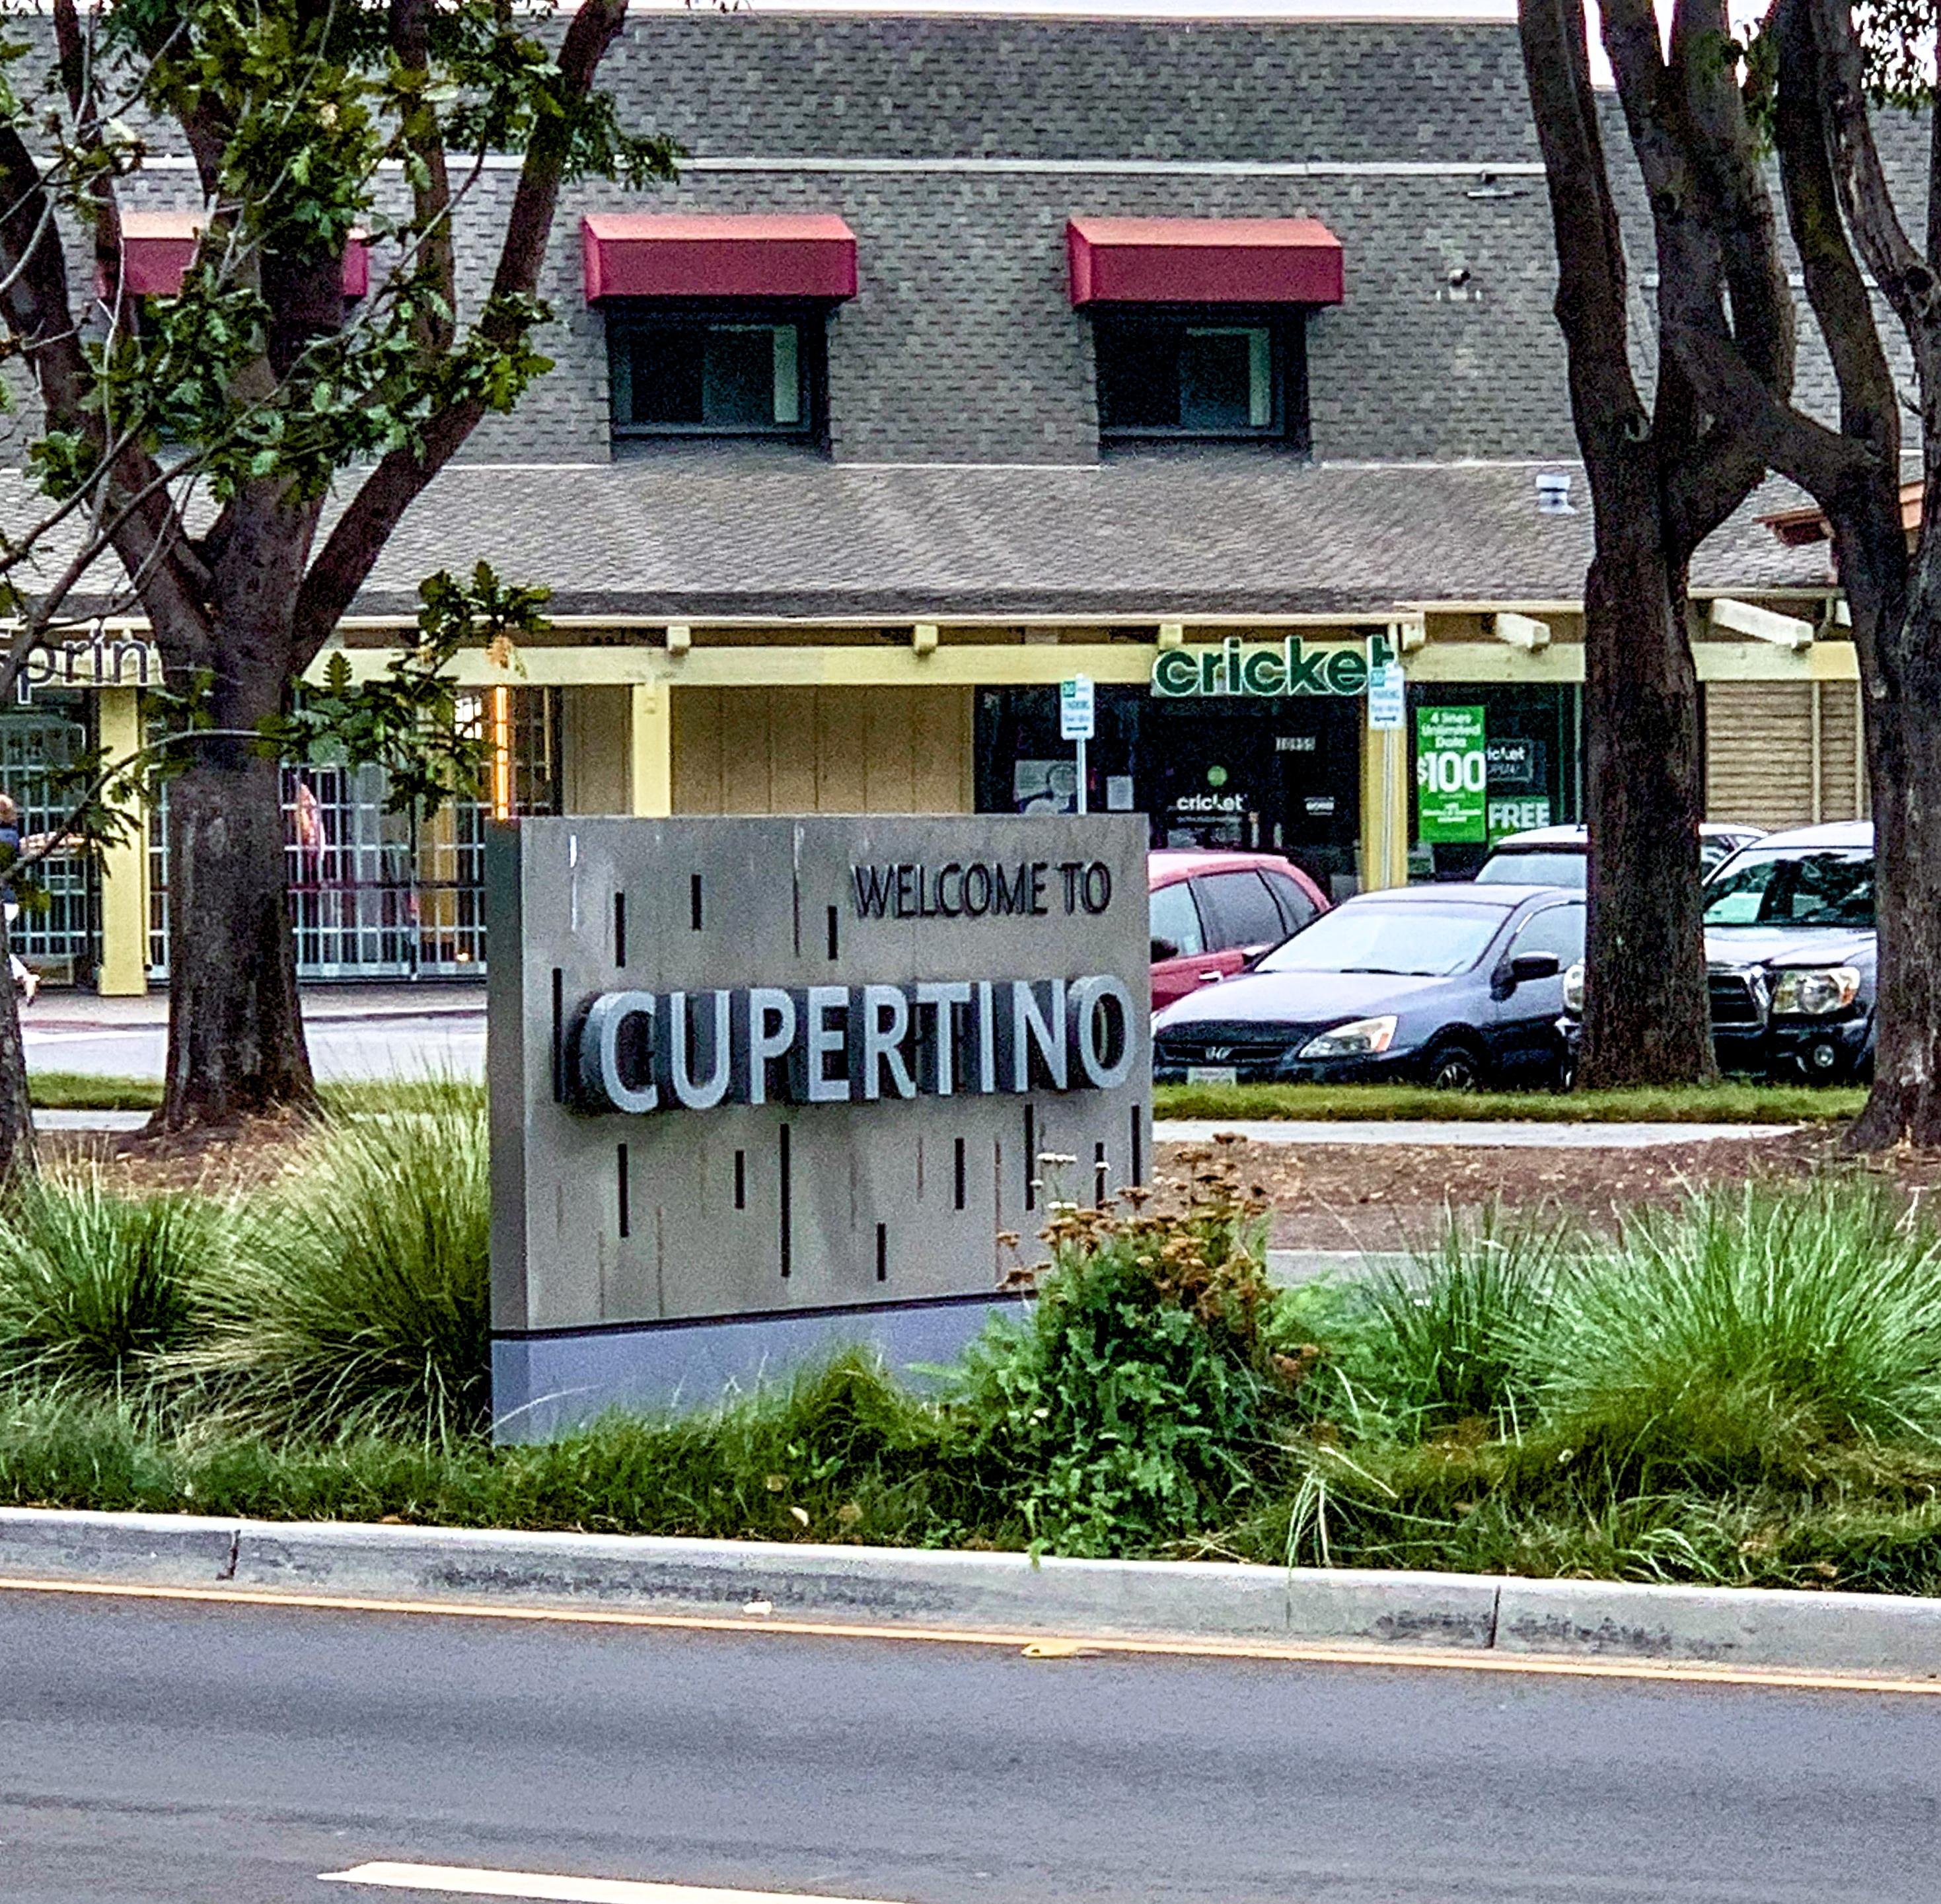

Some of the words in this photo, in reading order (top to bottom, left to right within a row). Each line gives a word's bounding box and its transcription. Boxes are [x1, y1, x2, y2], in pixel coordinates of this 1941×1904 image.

[0, 626, 164, 705] prin
[1152, 635, 1396, 696] cricket
[1417, 751, 1486, 793] $100
[1177, 793, 1243, 811] cricket
[1488, 803, 1550, 829] FREE
[852, 861, 1048, 917] WELCOME
[1055, 861, 1111, 914] TO
[583, 974, 1135, 1115] CUPERTINO
